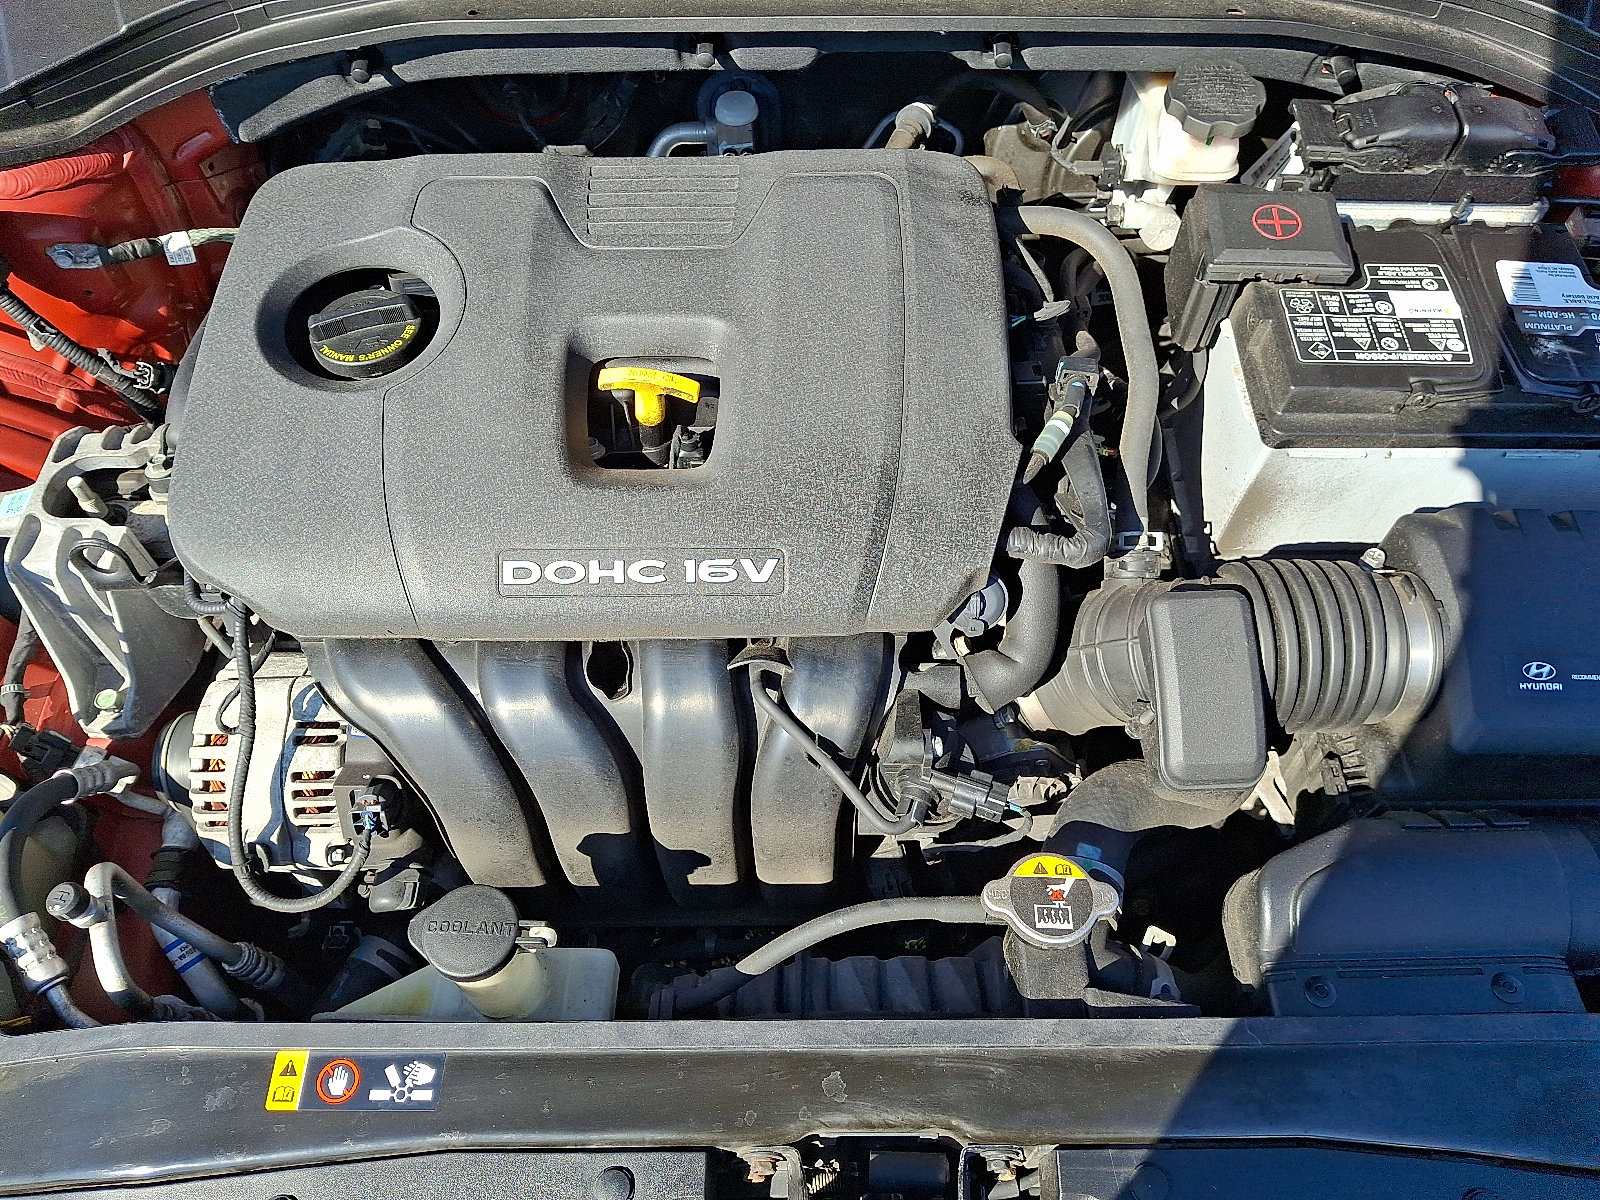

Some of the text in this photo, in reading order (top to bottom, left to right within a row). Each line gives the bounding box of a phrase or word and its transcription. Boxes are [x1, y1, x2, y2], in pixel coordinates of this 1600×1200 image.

[1538, 310, 1575, 319] H6-AGM
[1524, 322, 1573, 331] PLATINUM
[319, 324, 416, 363] SEE OWNER'S MANUAL
[502, 557, 781, 586] DOHC 16V
[1519, 682, 1563, 690] HYUNDAI
[53, 890, 70, 904] H
[427, 919, 517, 937] COOLANT
